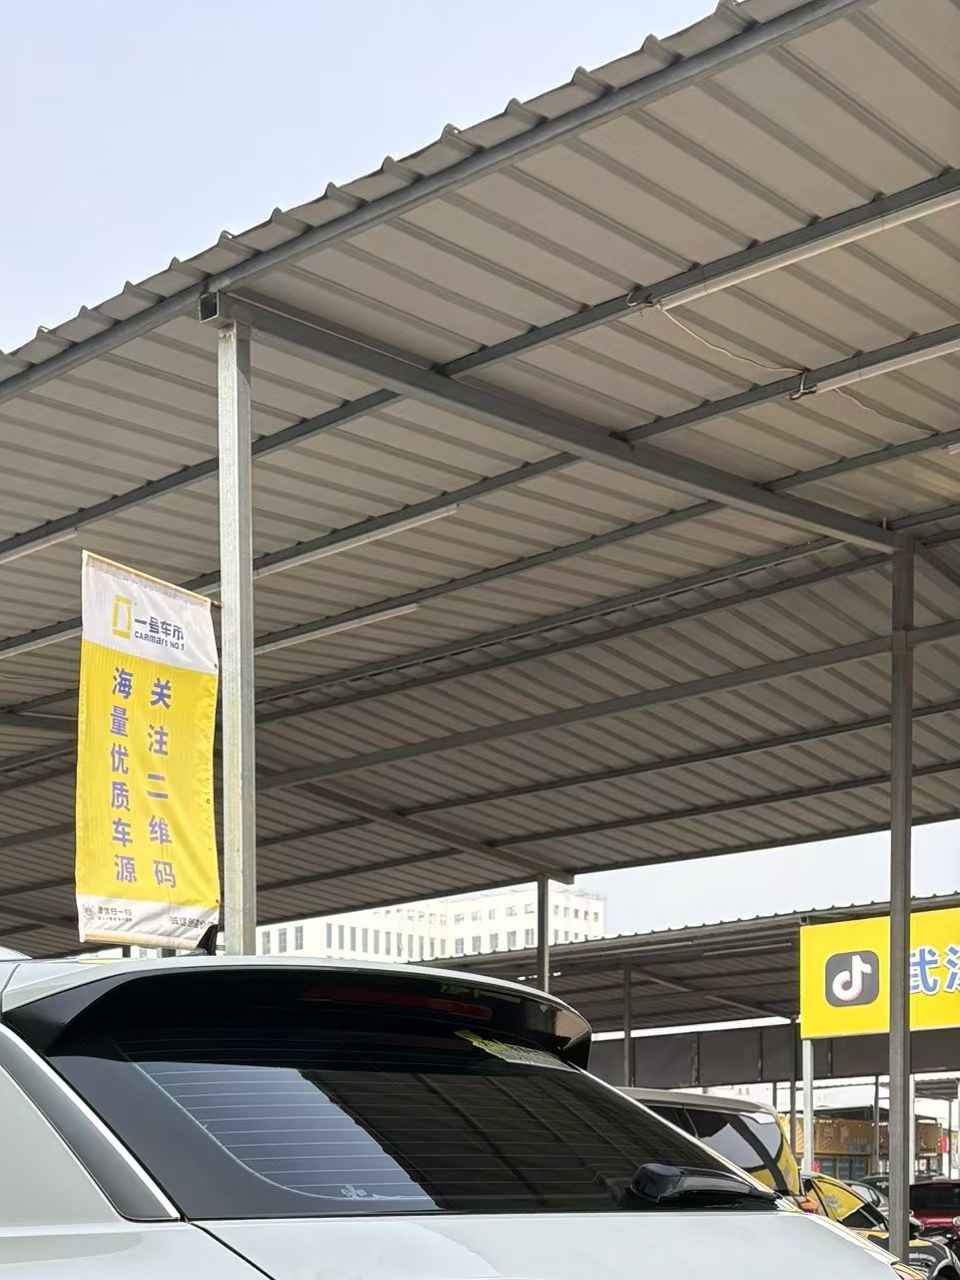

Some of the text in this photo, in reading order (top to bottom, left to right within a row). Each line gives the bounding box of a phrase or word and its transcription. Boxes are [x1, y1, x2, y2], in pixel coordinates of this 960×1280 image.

[134, 616, 184, 641] 一号车市
[110, 667, 137, 884] 海量优质车源
[147, 677, 176, 888] 关注二维码
